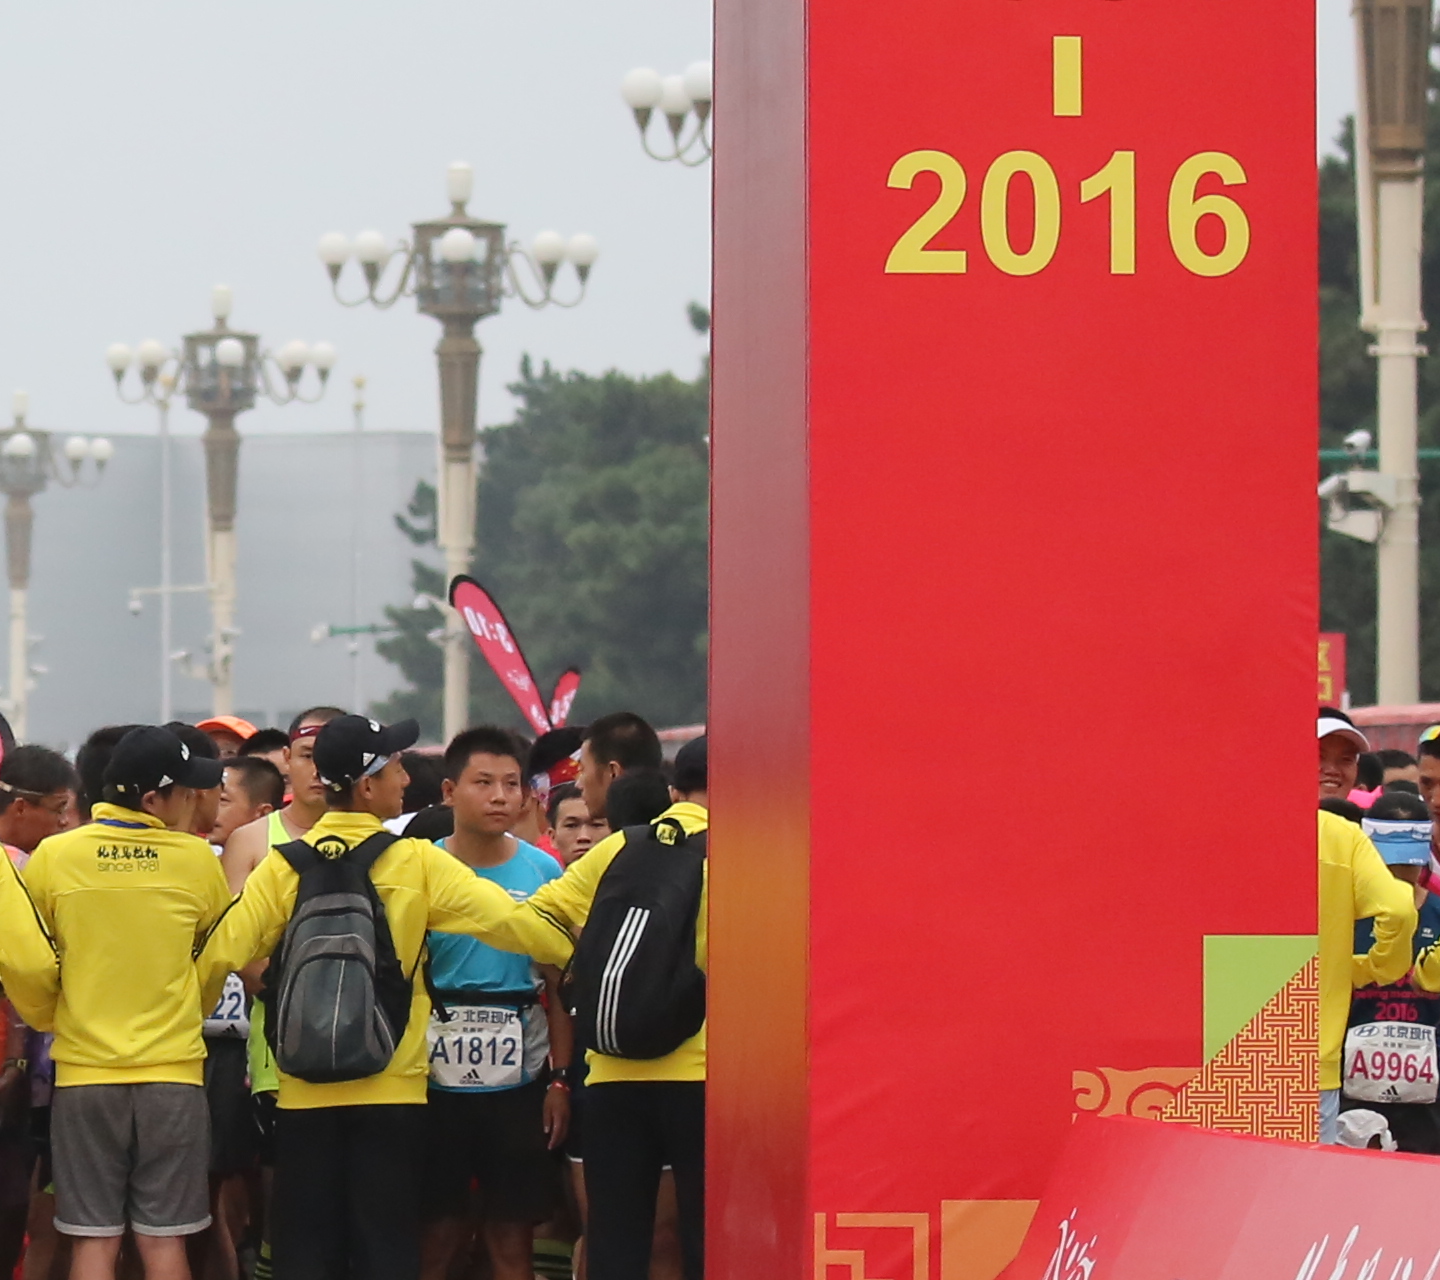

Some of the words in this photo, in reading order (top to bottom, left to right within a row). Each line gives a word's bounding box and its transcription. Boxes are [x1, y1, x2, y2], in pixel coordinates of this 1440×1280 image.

[883, 149, 1251, 278] 2016
[97, 861, 134, 873] since
[136, 859, 161, 872] 1981
[1374, 1002, 1419, 1022] 2016
[1382, 1025, 1434, 1043] 北京现代
[430, 1036, 517, 1067] A1812
[1348, 1050, 1435, 1084] A9964
